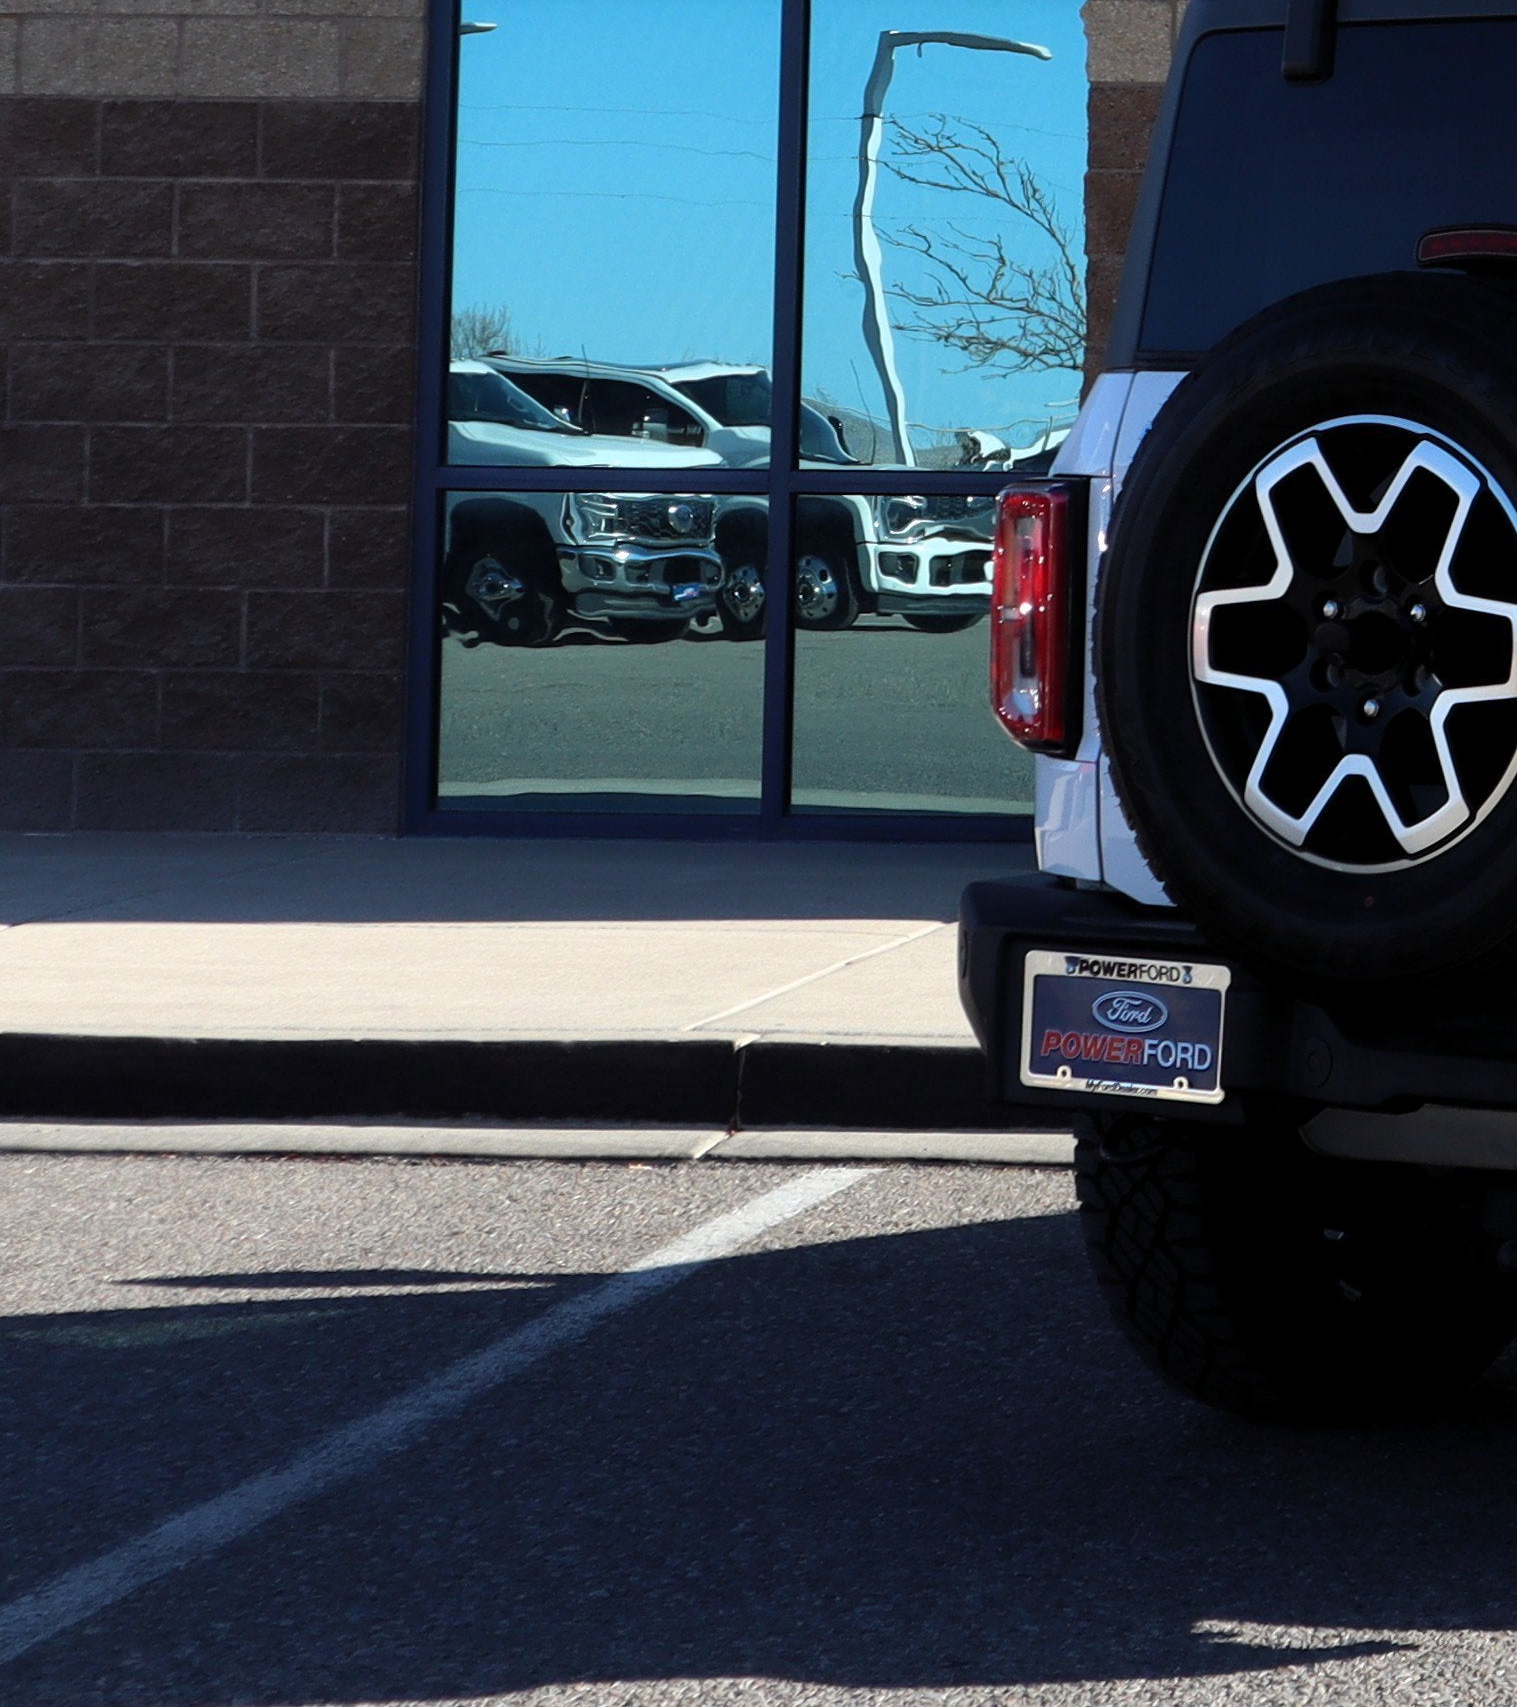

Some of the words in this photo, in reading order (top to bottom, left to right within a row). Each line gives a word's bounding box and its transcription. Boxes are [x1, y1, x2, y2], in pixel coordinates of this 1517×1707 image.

[1077, 959, 1180, 982] POWERFORD
[1107, 997, 1151, 1024] Ford
[1041, 1029, 1212, 1071] POWERFORD
